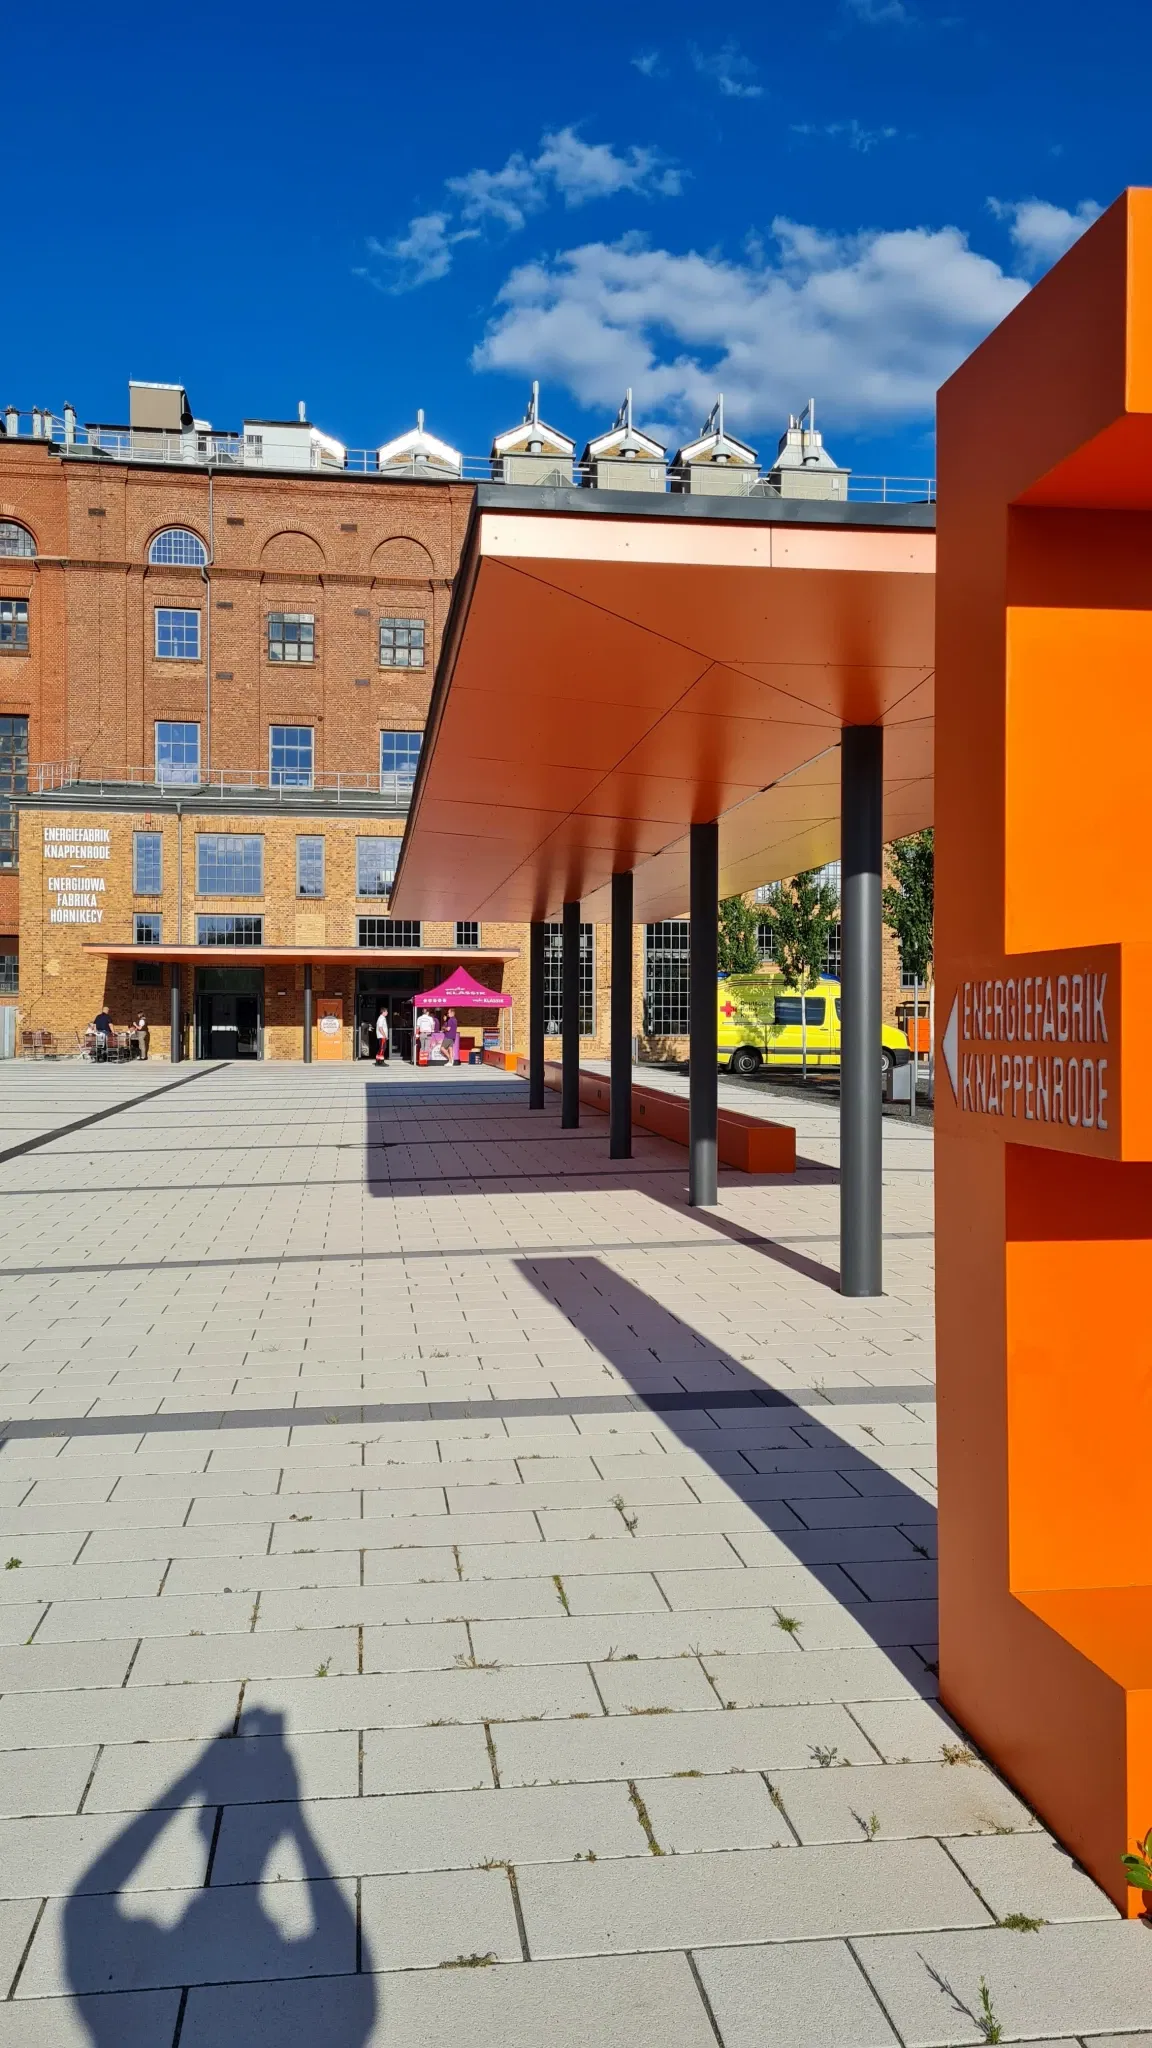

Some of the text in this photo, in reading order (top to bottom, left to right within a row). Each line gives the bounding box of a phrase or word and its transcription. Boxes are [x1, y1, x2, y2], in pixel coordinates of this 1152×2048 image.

[44, 828, 110, 842] ENERGIEFABRIK
[44, 845, 111, 860] KNAPPENRODE
[48, 877, 106, 892] ENERGIJOWA
[57, 893, 97, 907] FABRIKA
[962, 972, 1109, 1043] ENERGIEFABRIK
[962, 1053, 1108, 1129] KNAPPENRODE
